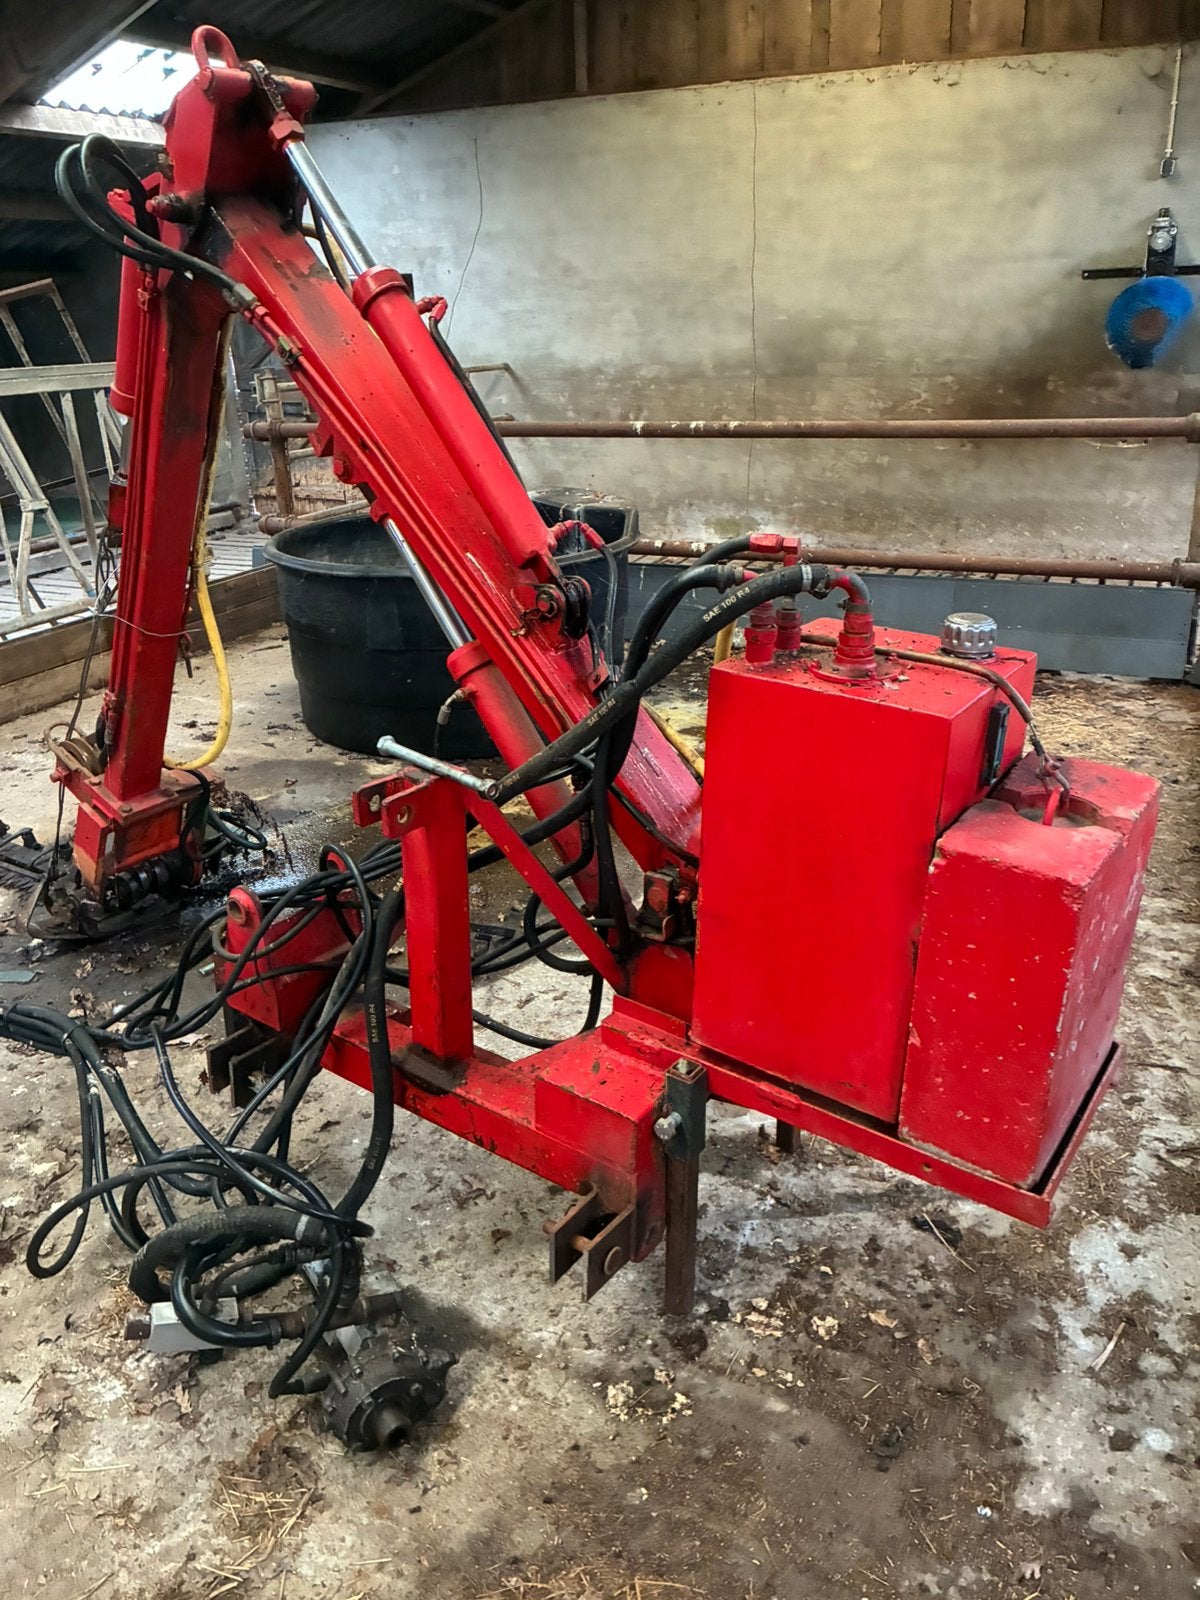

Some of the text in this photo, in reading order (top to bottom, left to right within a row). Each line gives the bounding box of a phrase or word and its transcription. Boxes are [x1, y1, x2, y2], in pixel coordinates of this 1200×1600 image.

[702, 586, 751, 623] SAE 100 R4
[587, 713, 600, 726] SAE
